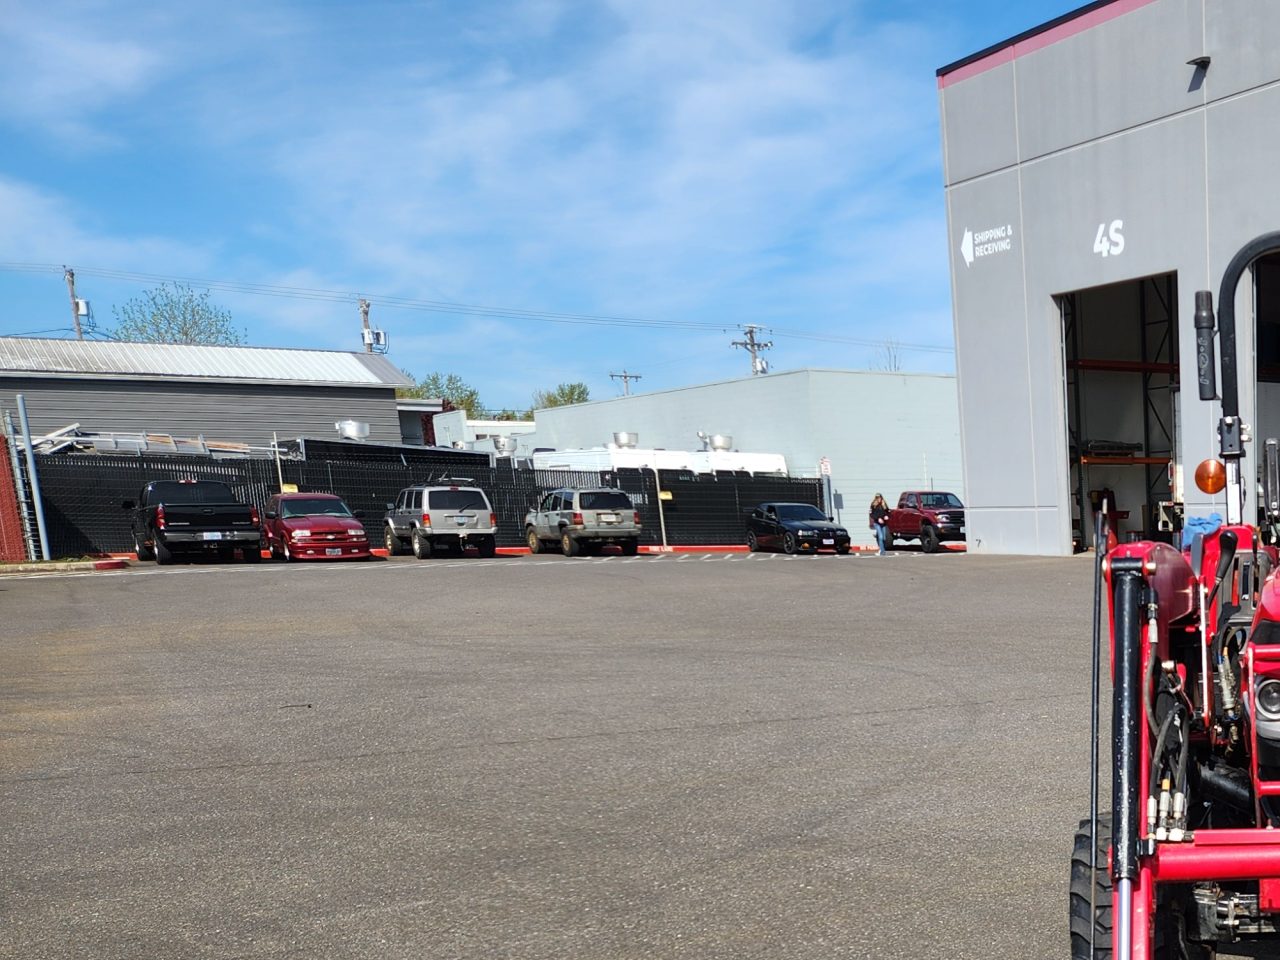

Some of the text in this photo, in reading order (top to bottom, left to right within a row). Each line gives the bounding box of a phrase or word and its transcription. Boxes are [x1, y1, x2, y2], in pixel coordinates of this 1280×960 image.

[974, 224, 1013, 245] SHIPPING &
[1093, 219, 1125, 257] 4S
[975, 238, 1011, 257] RECEIVING
